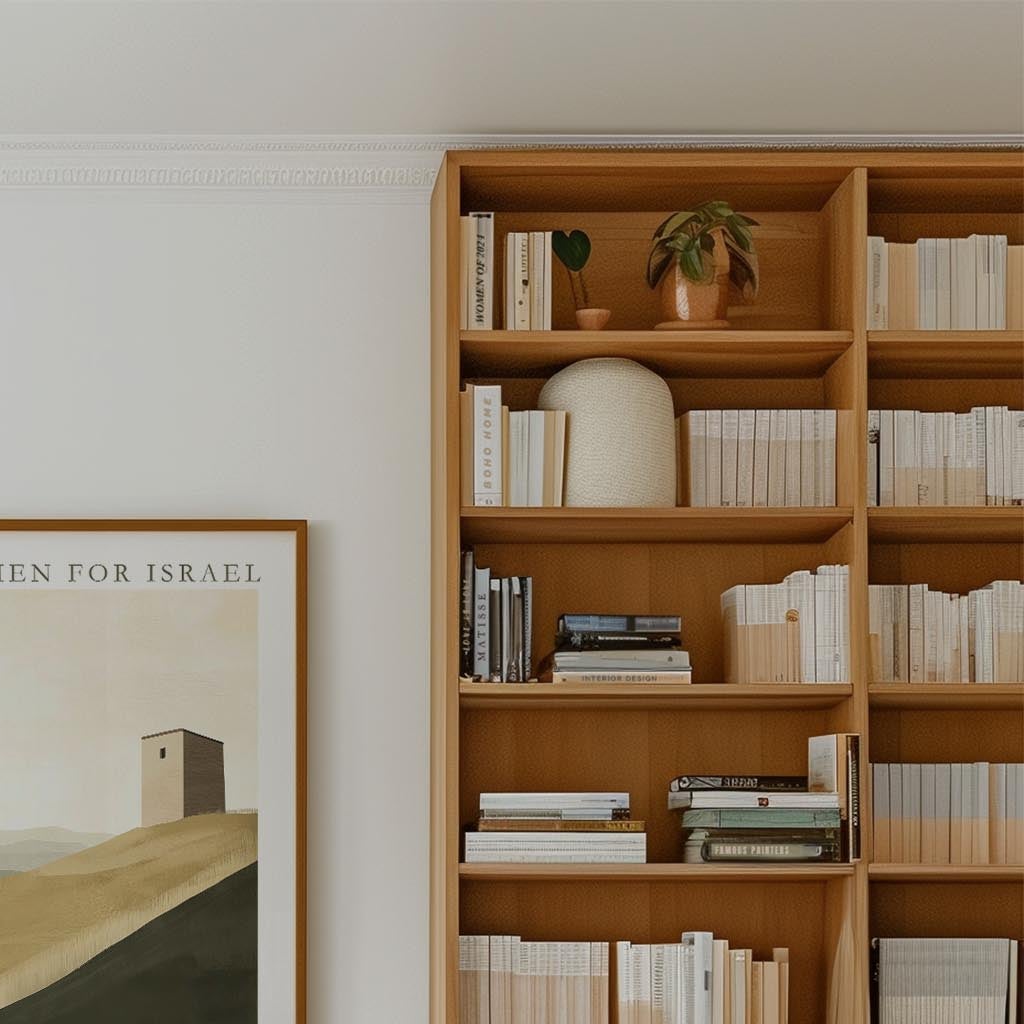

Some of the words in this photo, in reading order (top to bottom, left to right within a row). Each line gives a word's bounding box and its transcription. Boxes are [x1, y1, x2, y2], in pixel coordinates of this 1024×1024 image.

[475, 234, 486, 257] 2024
[475, 259, 486, 276] OF
[475, 278, 486, 324] WOMEN
[482, 397, 493, 440] HOME
[482, 447, 493, 489] BOHO
[68, 563, 131, 583] FOR
[147, 563, 262, 583] ISRAEL
[477, 592, 487, 662] MATISSE
[581, 675, 623, 683] INTERIOR
[625, 675, 658, 683] DESIGN
[714, 846, 748, 855] FAMOUS
[751, 846, 790, 855] PAINTERS
